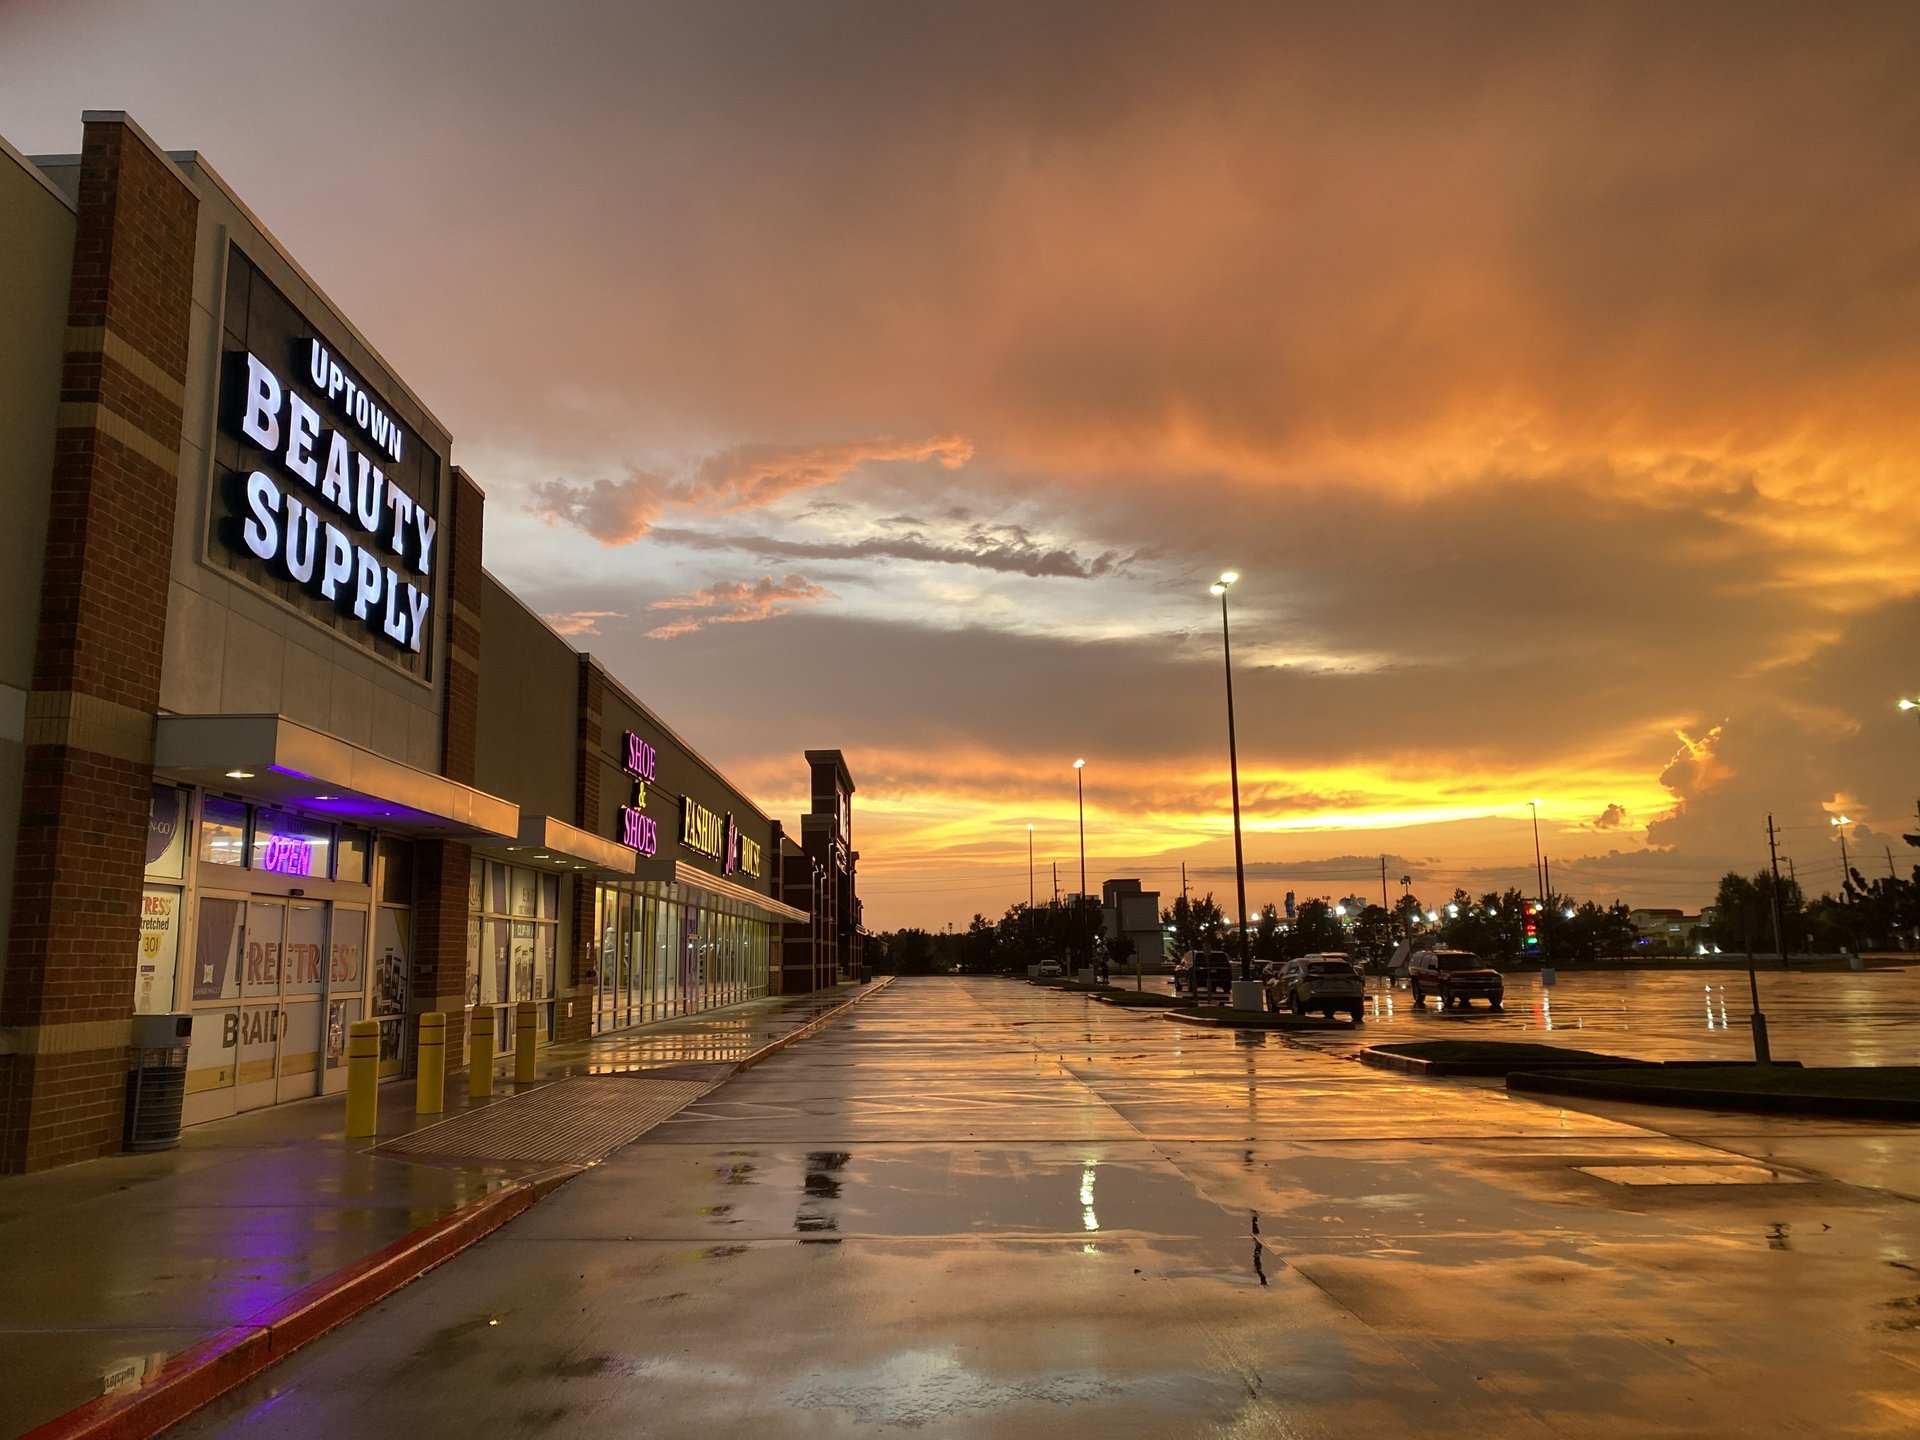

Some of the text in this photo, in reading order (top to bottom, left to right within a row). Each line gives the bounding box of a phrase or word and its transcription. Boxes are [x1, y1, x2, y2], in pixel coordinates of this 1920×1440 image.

[311, 338, 403, 464] UPTOWN
[242, 351, 436, 576] BEAUTY
[243, 470, 430, 653] SUPPLY
[628, 732, 656, 782] SHOE
[638, 781, 647, 808] &
[265, 835, 310, 875] OPEN
[623, 807, 657, 855] SHOES
[684, 796, 723, 859] FASHION
[741, 834, 761, 878] HOUSE
[144, 936, 159, 952] 301
[222, 1009, 288, 1048] BRAID
